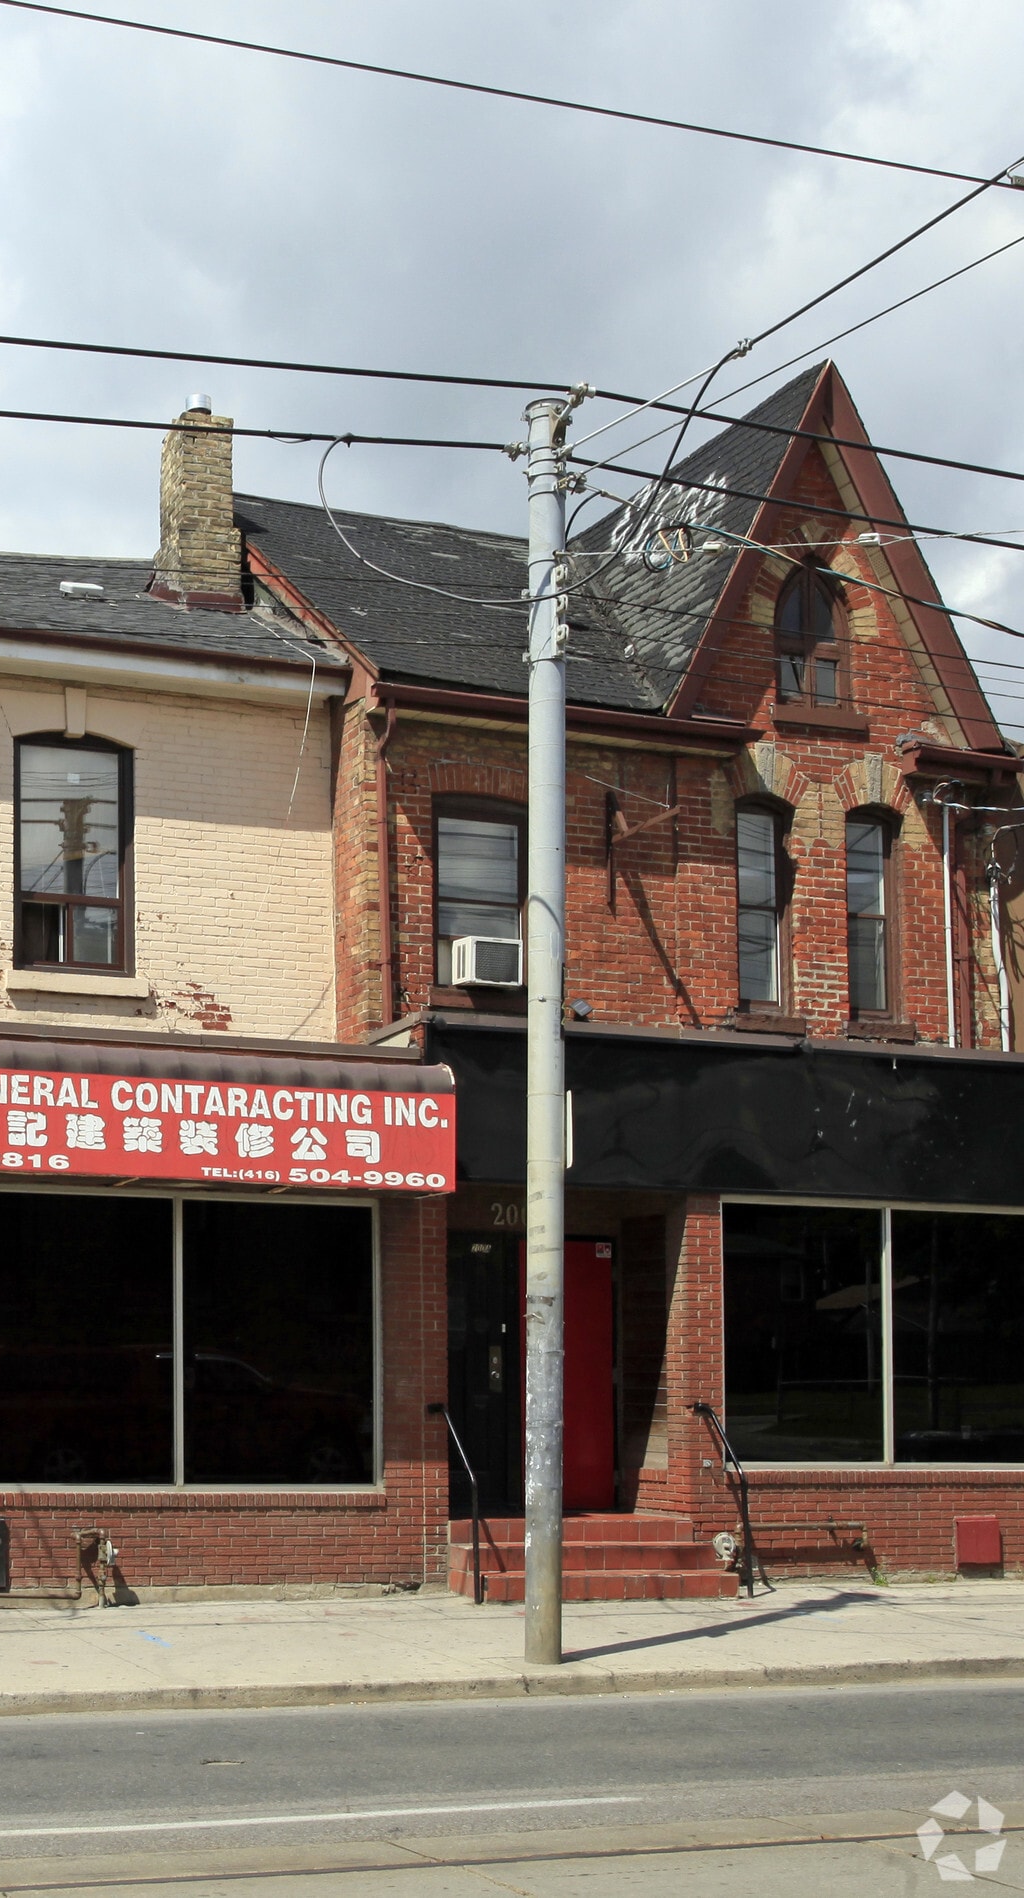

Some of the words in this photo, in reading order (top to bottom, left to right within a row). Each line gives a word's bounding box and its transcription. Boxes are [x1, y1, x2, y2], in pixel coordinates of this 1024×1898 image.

[110, 1079, 373, 1125] CONTARACTING
[383, 1096, 448, 1129] INC.
[200, 1166, 281, 1182] TEL:(416)
[288, 1167, 446, 1188] 504-9960
[490, 1202, 526, 1226] 20
